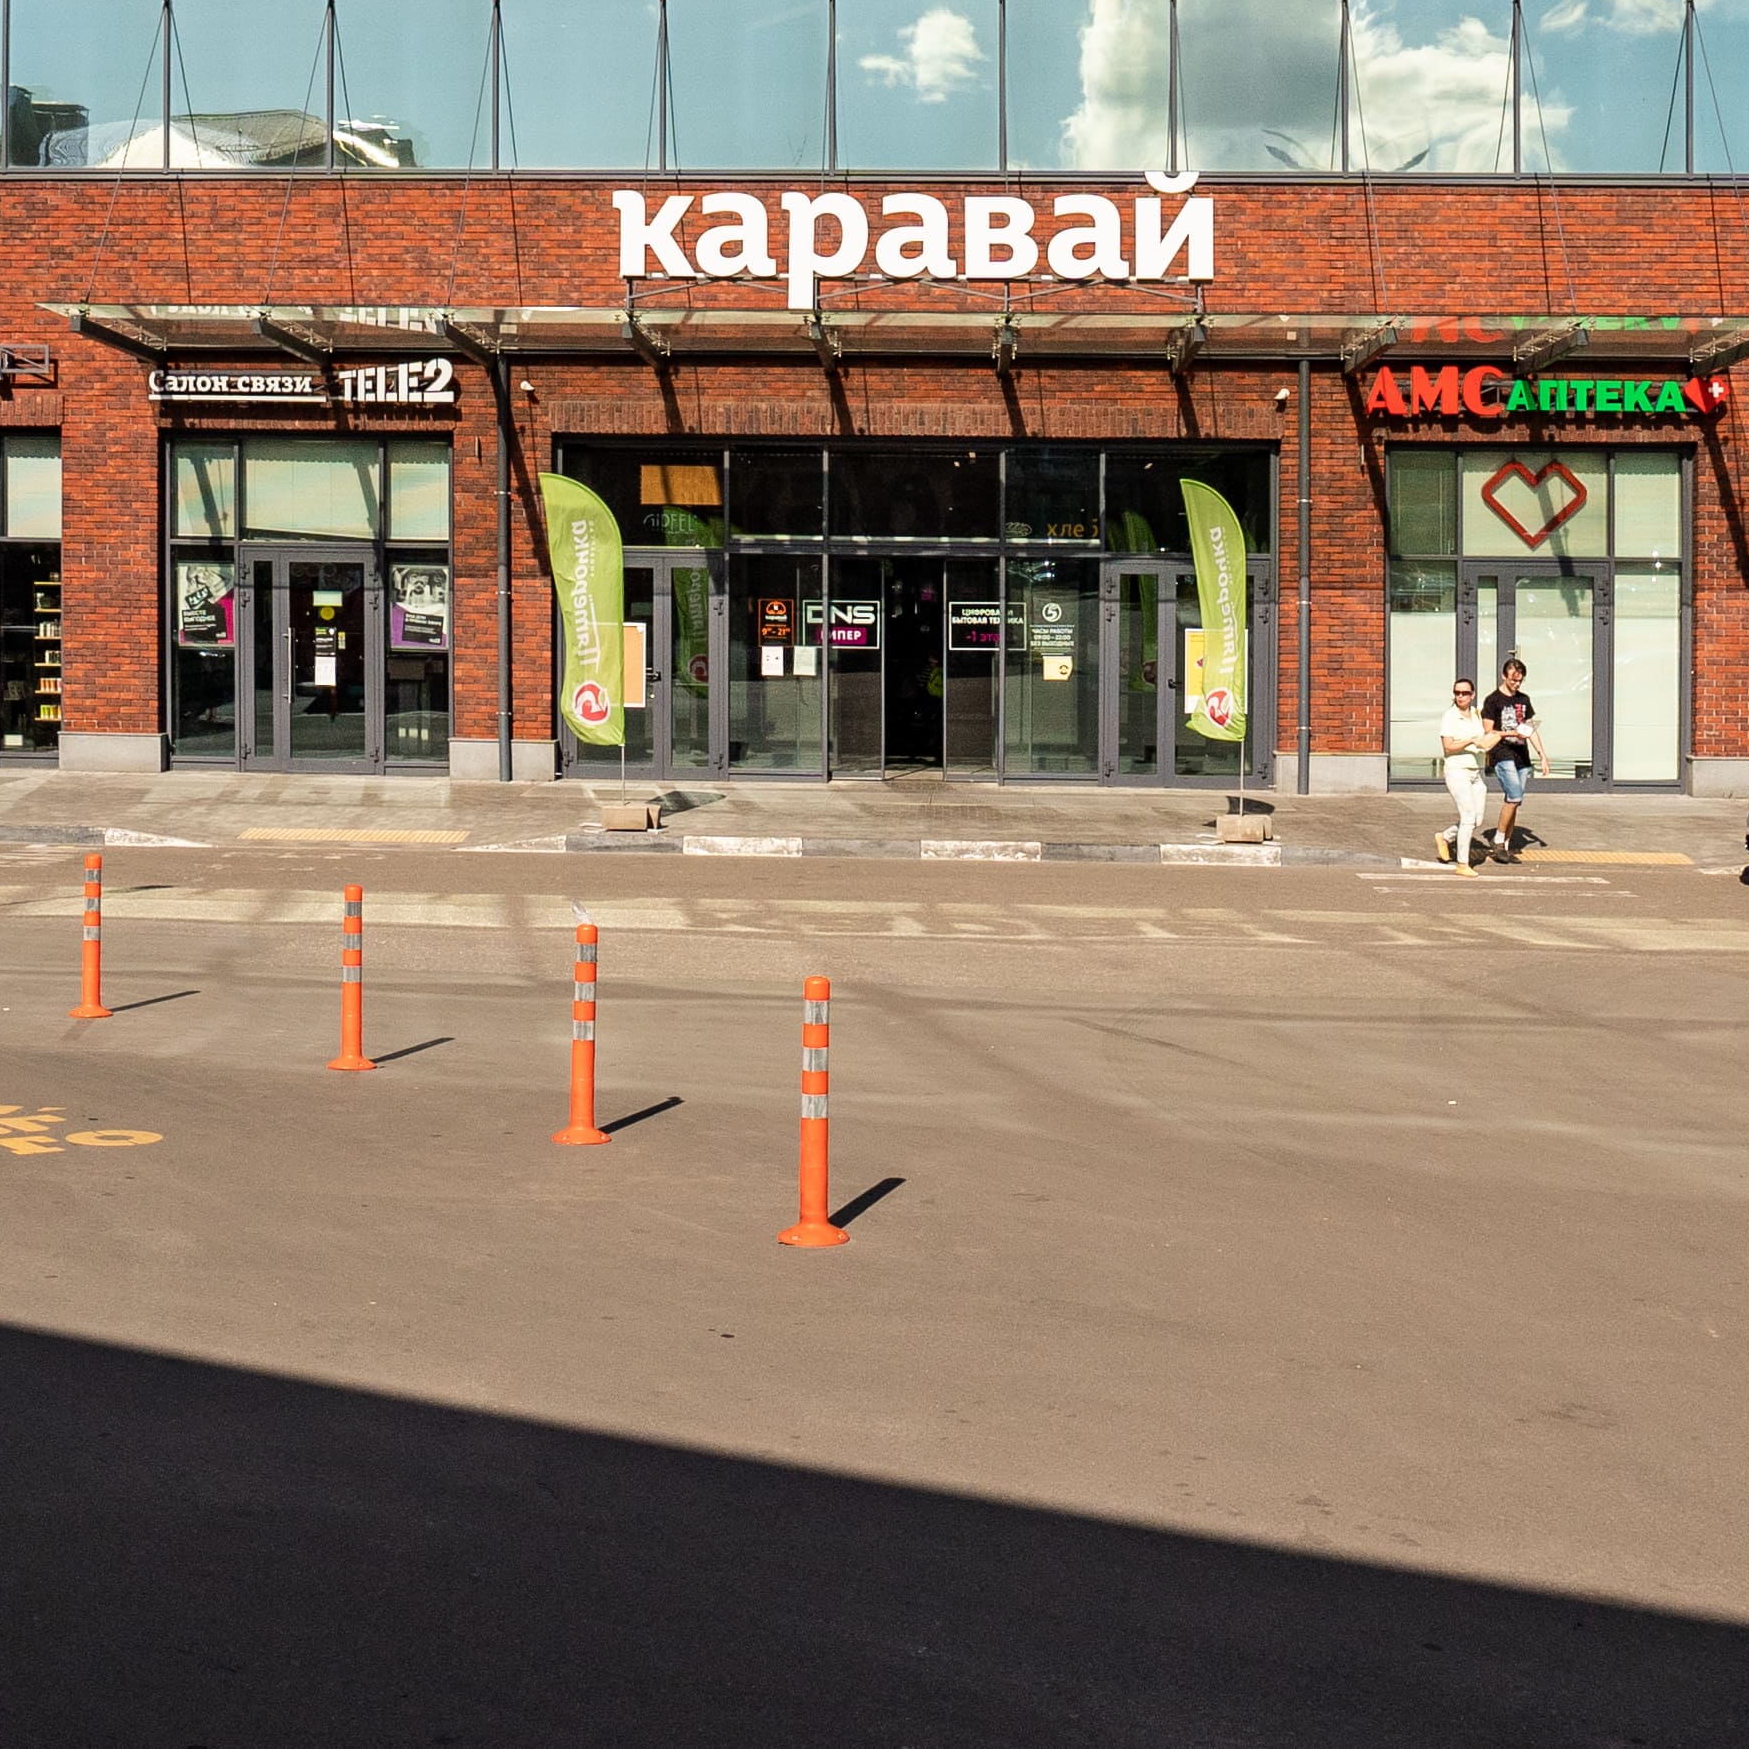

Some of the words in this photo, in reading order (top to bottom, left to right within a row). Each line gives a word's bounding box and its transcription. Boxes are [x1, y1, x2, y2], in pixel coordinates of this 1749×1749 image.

[611, 171, 1215, 309] каравай
[148, 370, 228, 393] Салон
[237, 373, 313, 394] связи
[339, 358, 455, 403] TELE2
[1506, 379, 1687, 412] АПТЕКА
[806, 605, 876, 625] DNS
[961, 608, 1001, 616] ЦИФРОВА
[988, 616, 1024, 625] ТЕИКА
[979, 633, 1001, 642] эта
